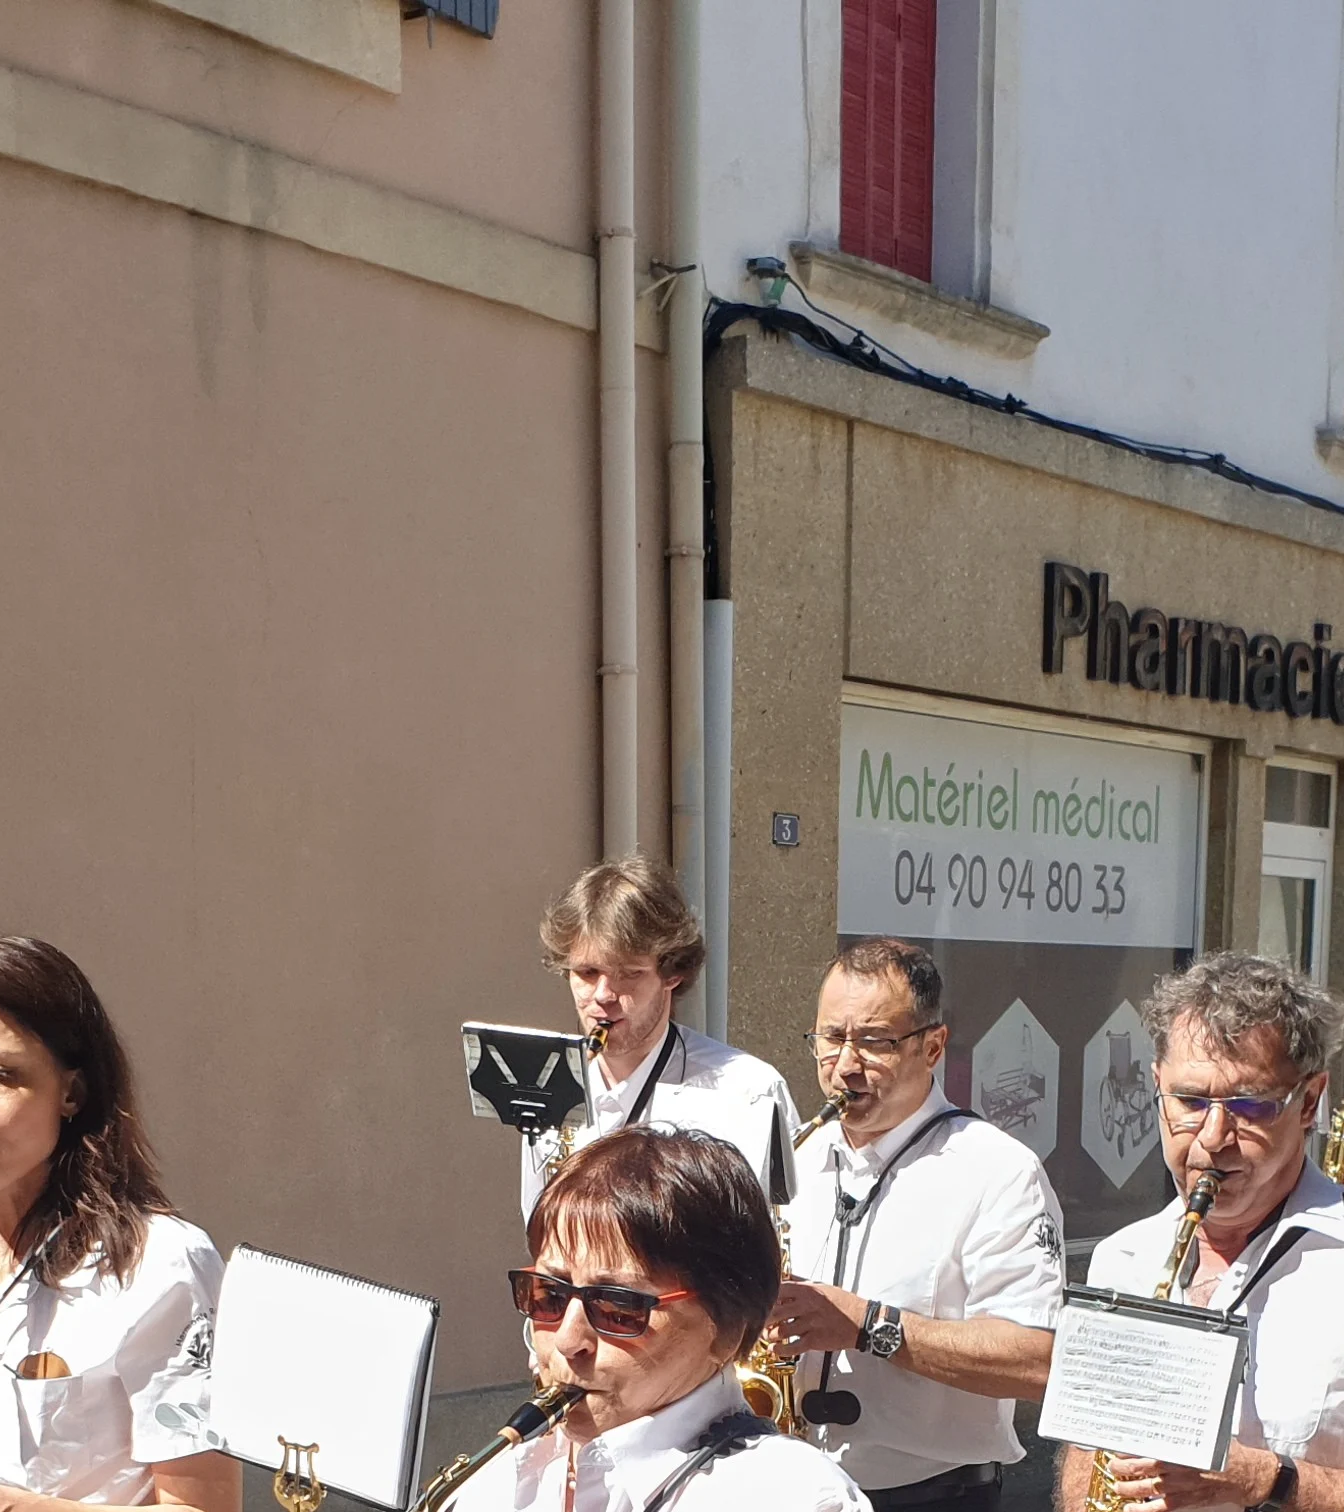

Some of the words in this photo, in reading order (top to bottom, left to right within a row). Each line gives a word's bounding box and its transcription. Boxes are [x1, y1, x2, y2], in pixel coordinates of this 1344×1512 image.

[782, 819, 791, 841] 3
[856, 749, 1018, 831] Matériel
[1032, 777, 1160, 845] médical
[894, 849, 936, 906] 04
[947, 853, 988, 909] 90
[997, 857, 1036, 910] 94
[1045, 860, 1083, 913] 80
[1091, 864, 1126, 915] 33
